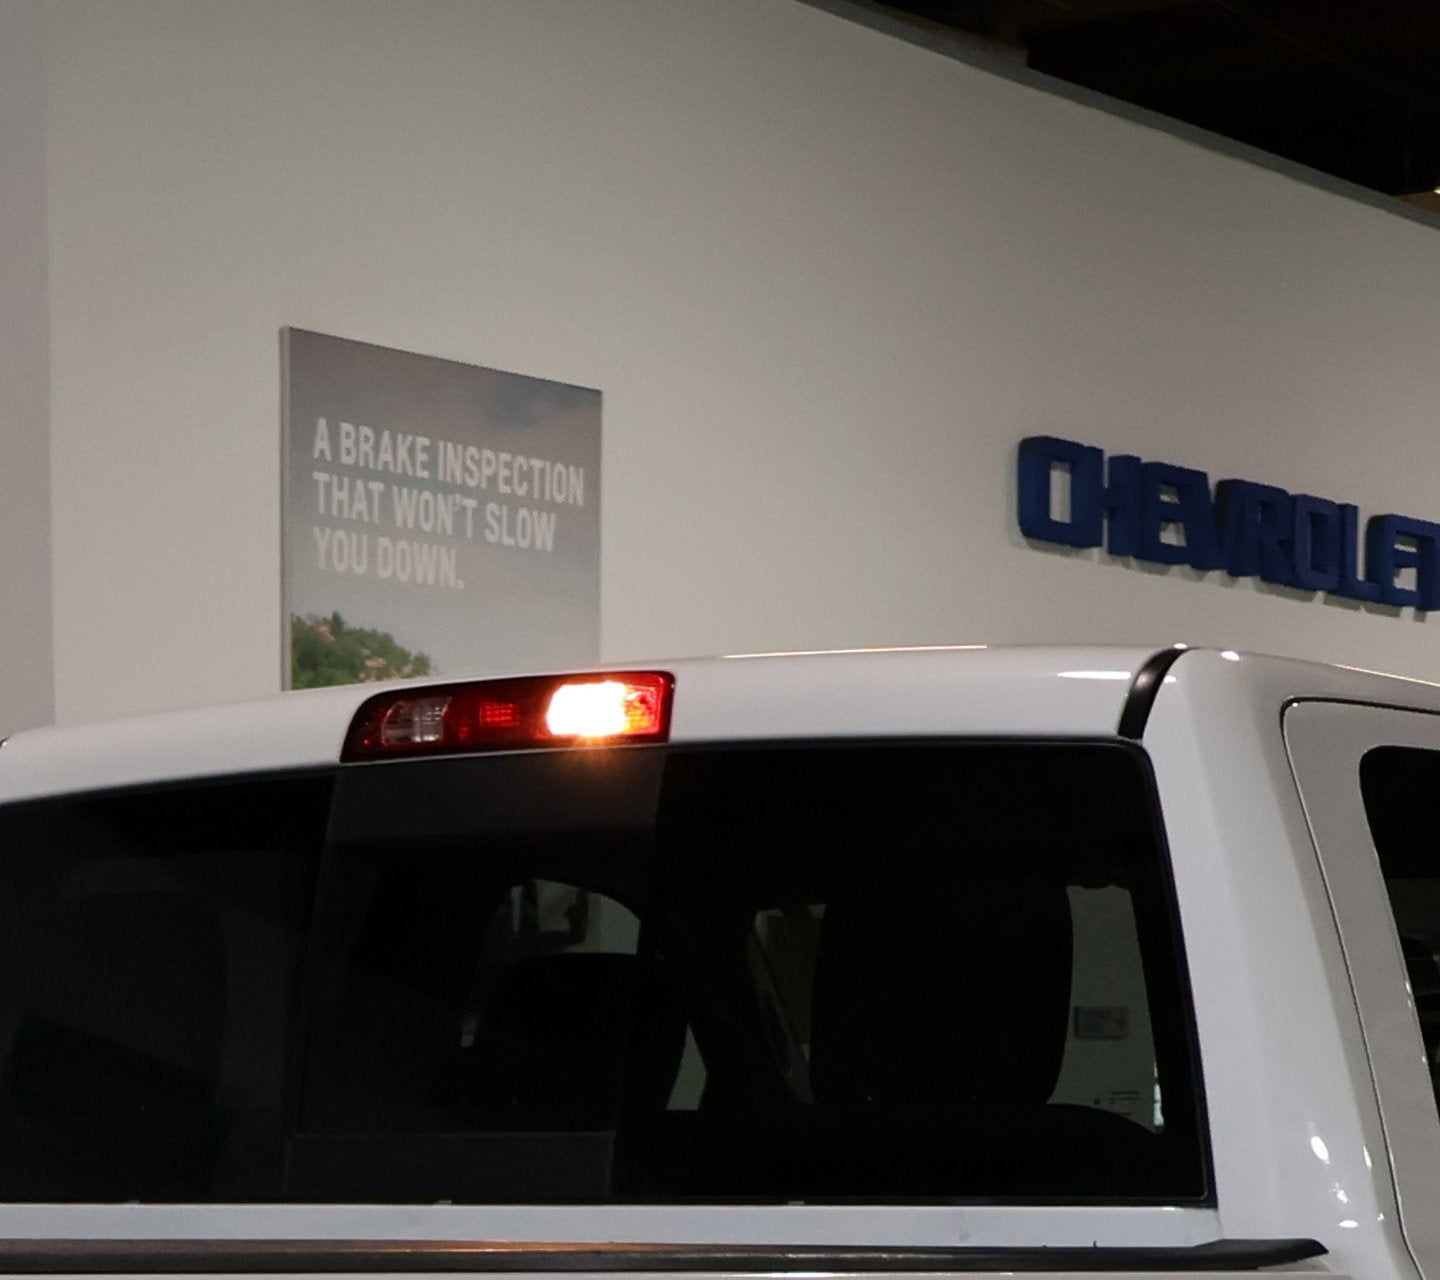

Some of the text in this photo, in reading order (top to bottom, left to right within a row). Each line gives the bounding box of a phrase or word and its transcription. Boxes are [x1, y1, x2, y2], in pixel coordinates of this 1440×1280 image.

[313, 418, 584, 507] A BRAKE INSPECTION
[312, 471, 557, 551] THAT WON'T SLOW
[313, 526, 465, 590] YOU DOWN.
